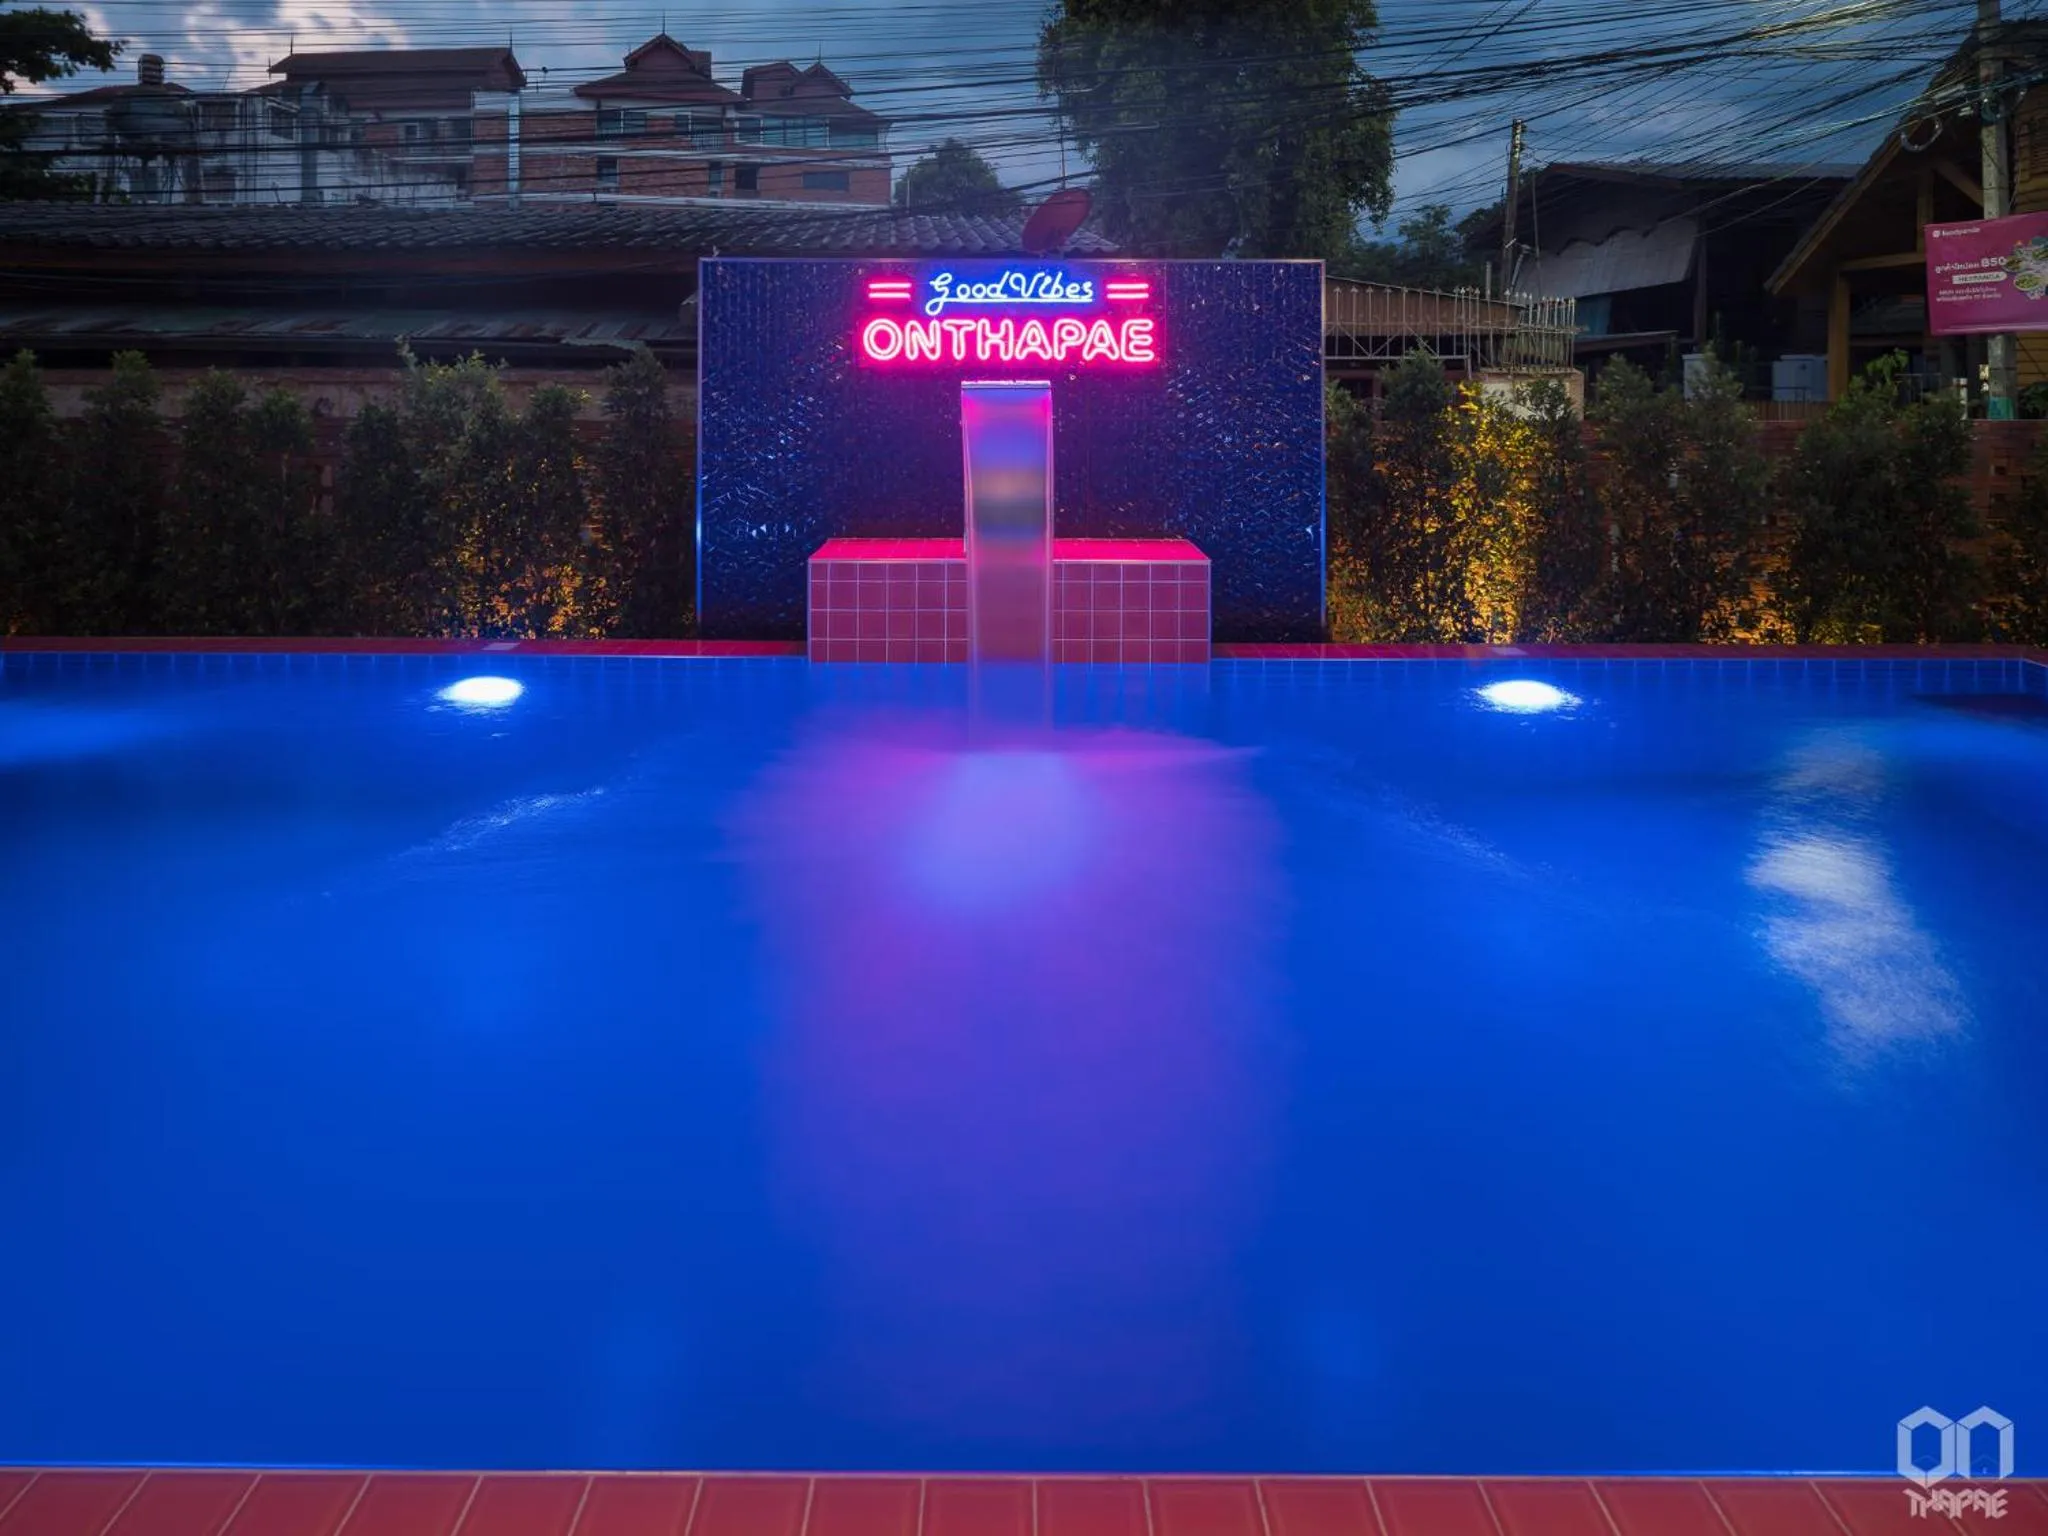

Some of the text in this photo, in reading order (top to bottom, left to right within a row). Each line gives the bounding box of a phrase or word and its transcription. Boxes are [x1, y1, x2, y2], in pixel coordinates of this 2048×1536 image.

[925, 271, 1094, 315] Good Vibes
[863, 318, 1155, 361] ONTHAPAE
